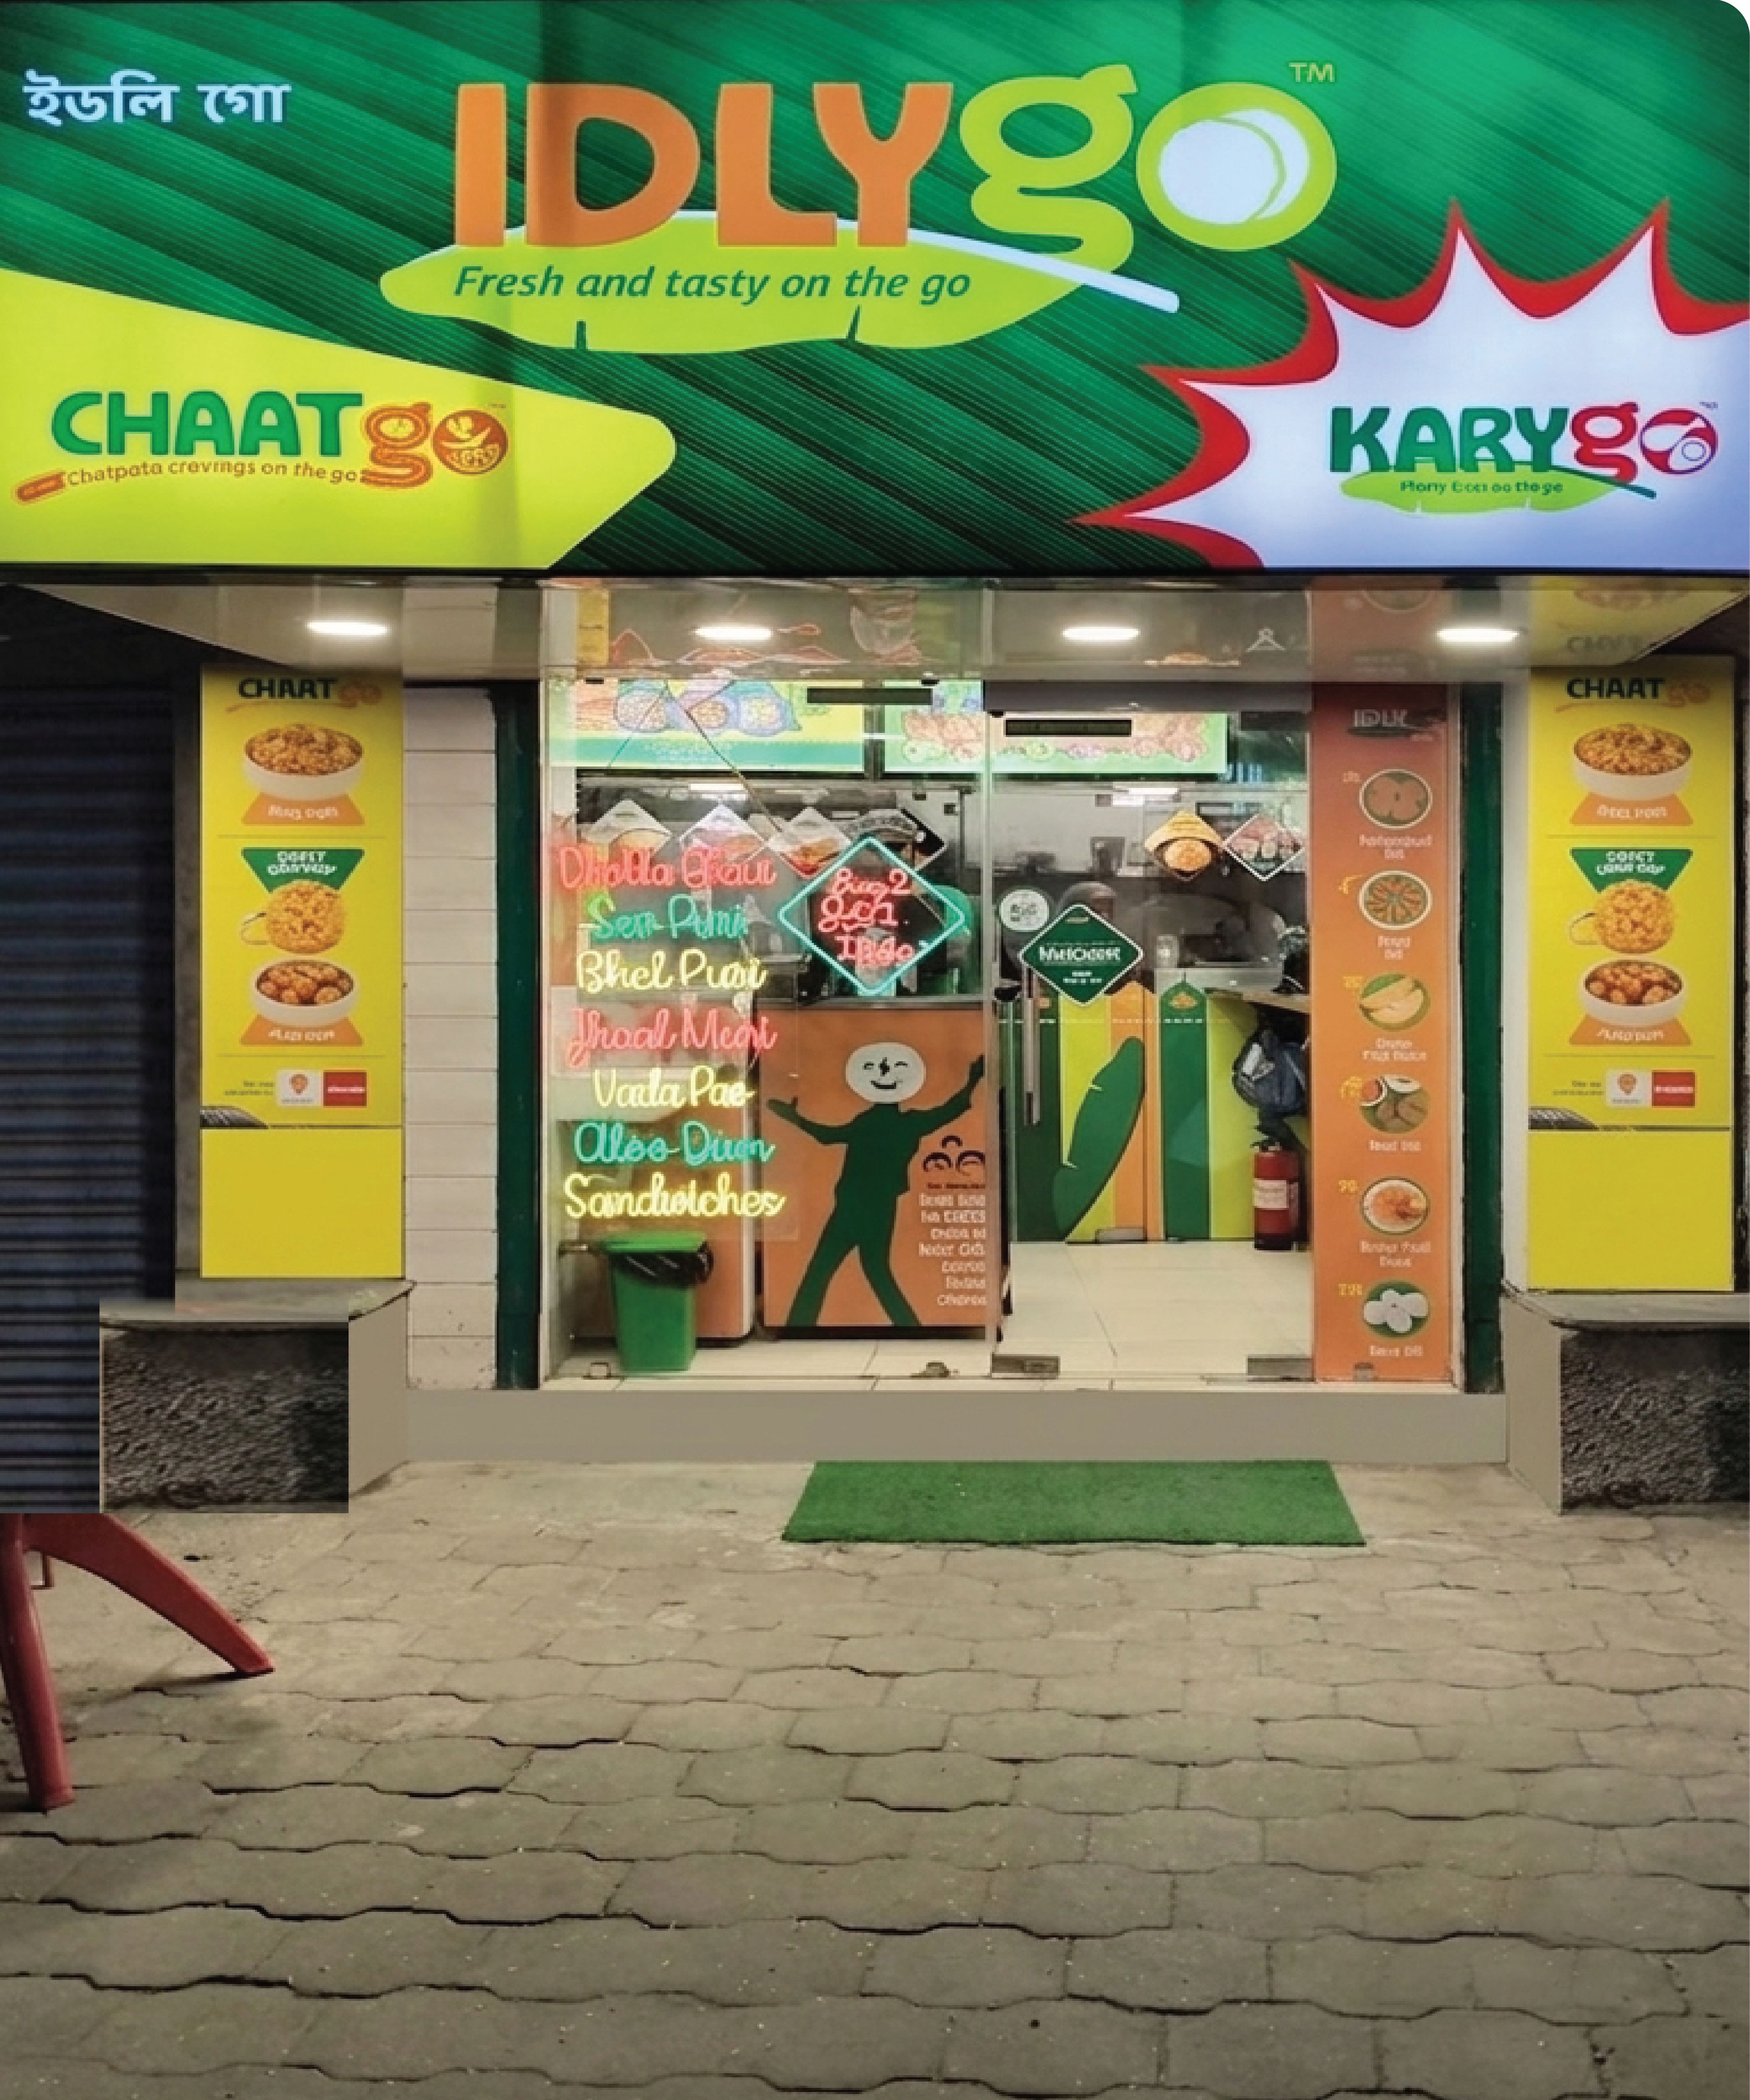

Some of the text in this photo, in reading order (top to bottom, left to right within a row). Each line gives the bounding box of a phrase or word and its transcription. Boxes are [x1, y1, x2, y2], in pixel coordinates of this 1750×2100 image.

[1290, 63, 1335, 83] TM
[23, 69, 291, 125] ইডলি গো
[454, 265, 970, 305] Fresh and tasty on the go
[261, 461, 289, 476] on
[331, 470, 357, 484] go
